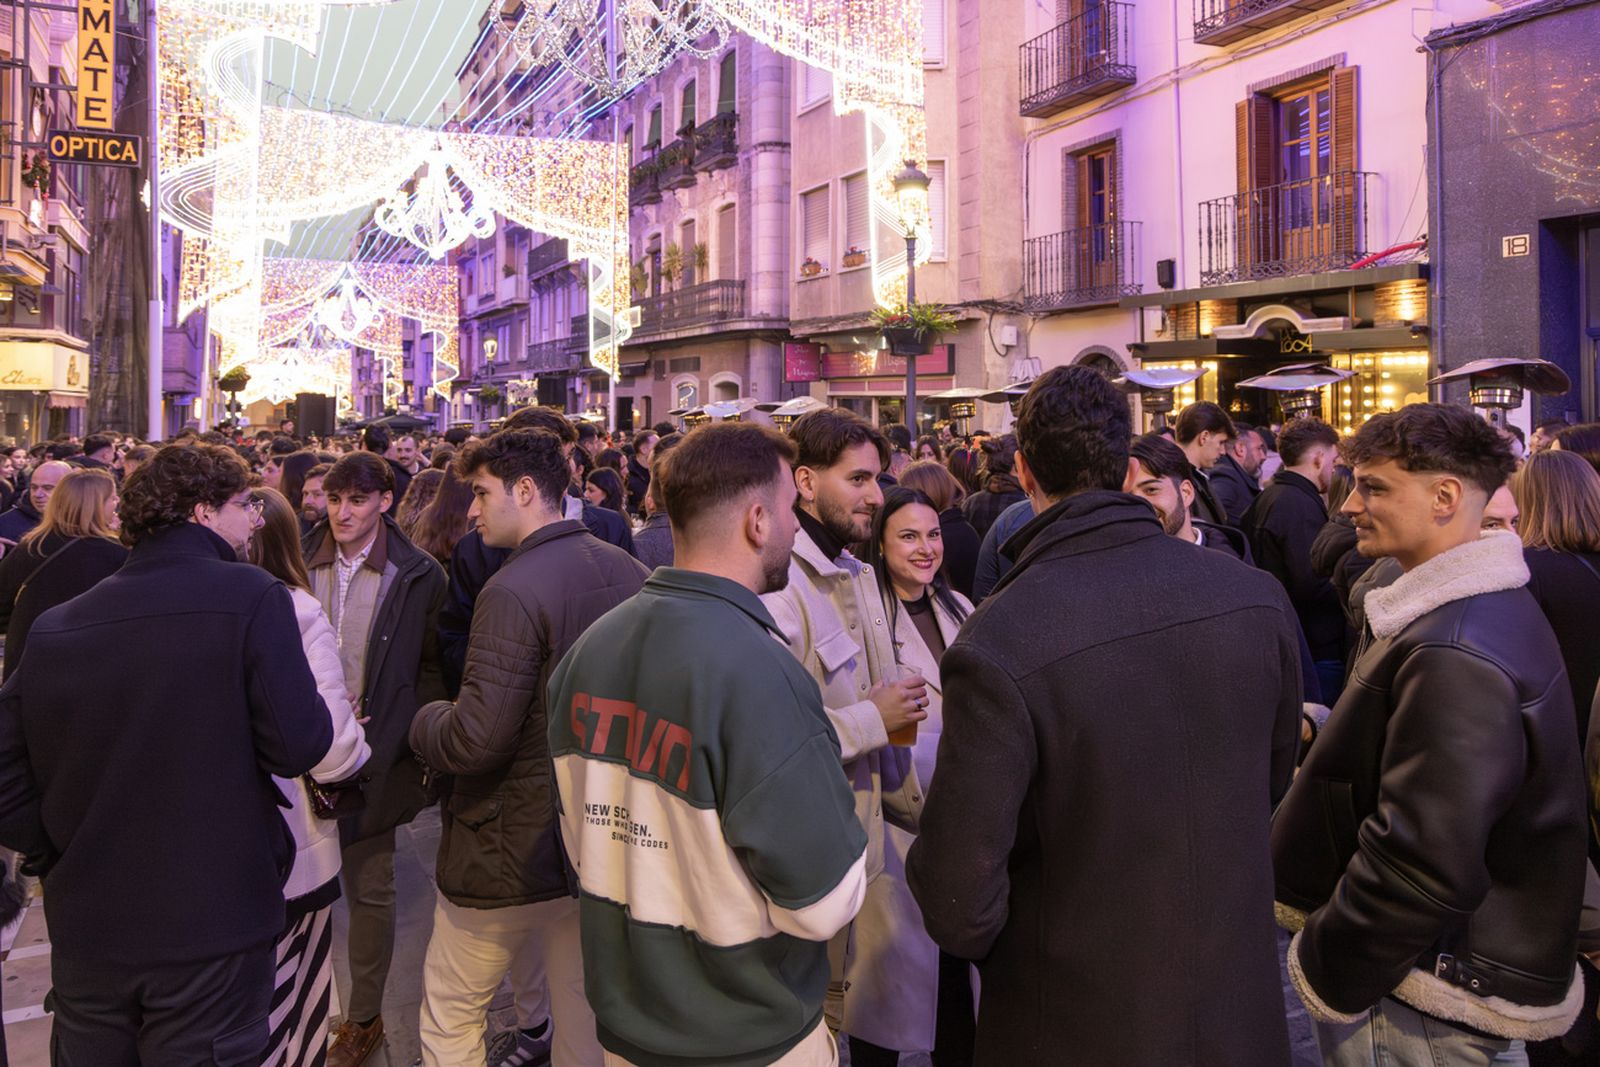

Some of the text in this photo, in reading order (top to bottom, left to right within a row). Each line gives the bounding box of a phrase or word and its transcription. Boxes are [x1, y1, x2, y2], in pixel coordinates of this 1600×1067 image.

[82, 0, 111, 122] MATE
[51, 136, 137, 162] OPTICA
[1504, 237, 1528, 256] 18
[584, 803, 610, 816] NEW
[586, 817, 611, 826] THOSE
[641, 839, 669, 850] CODES
